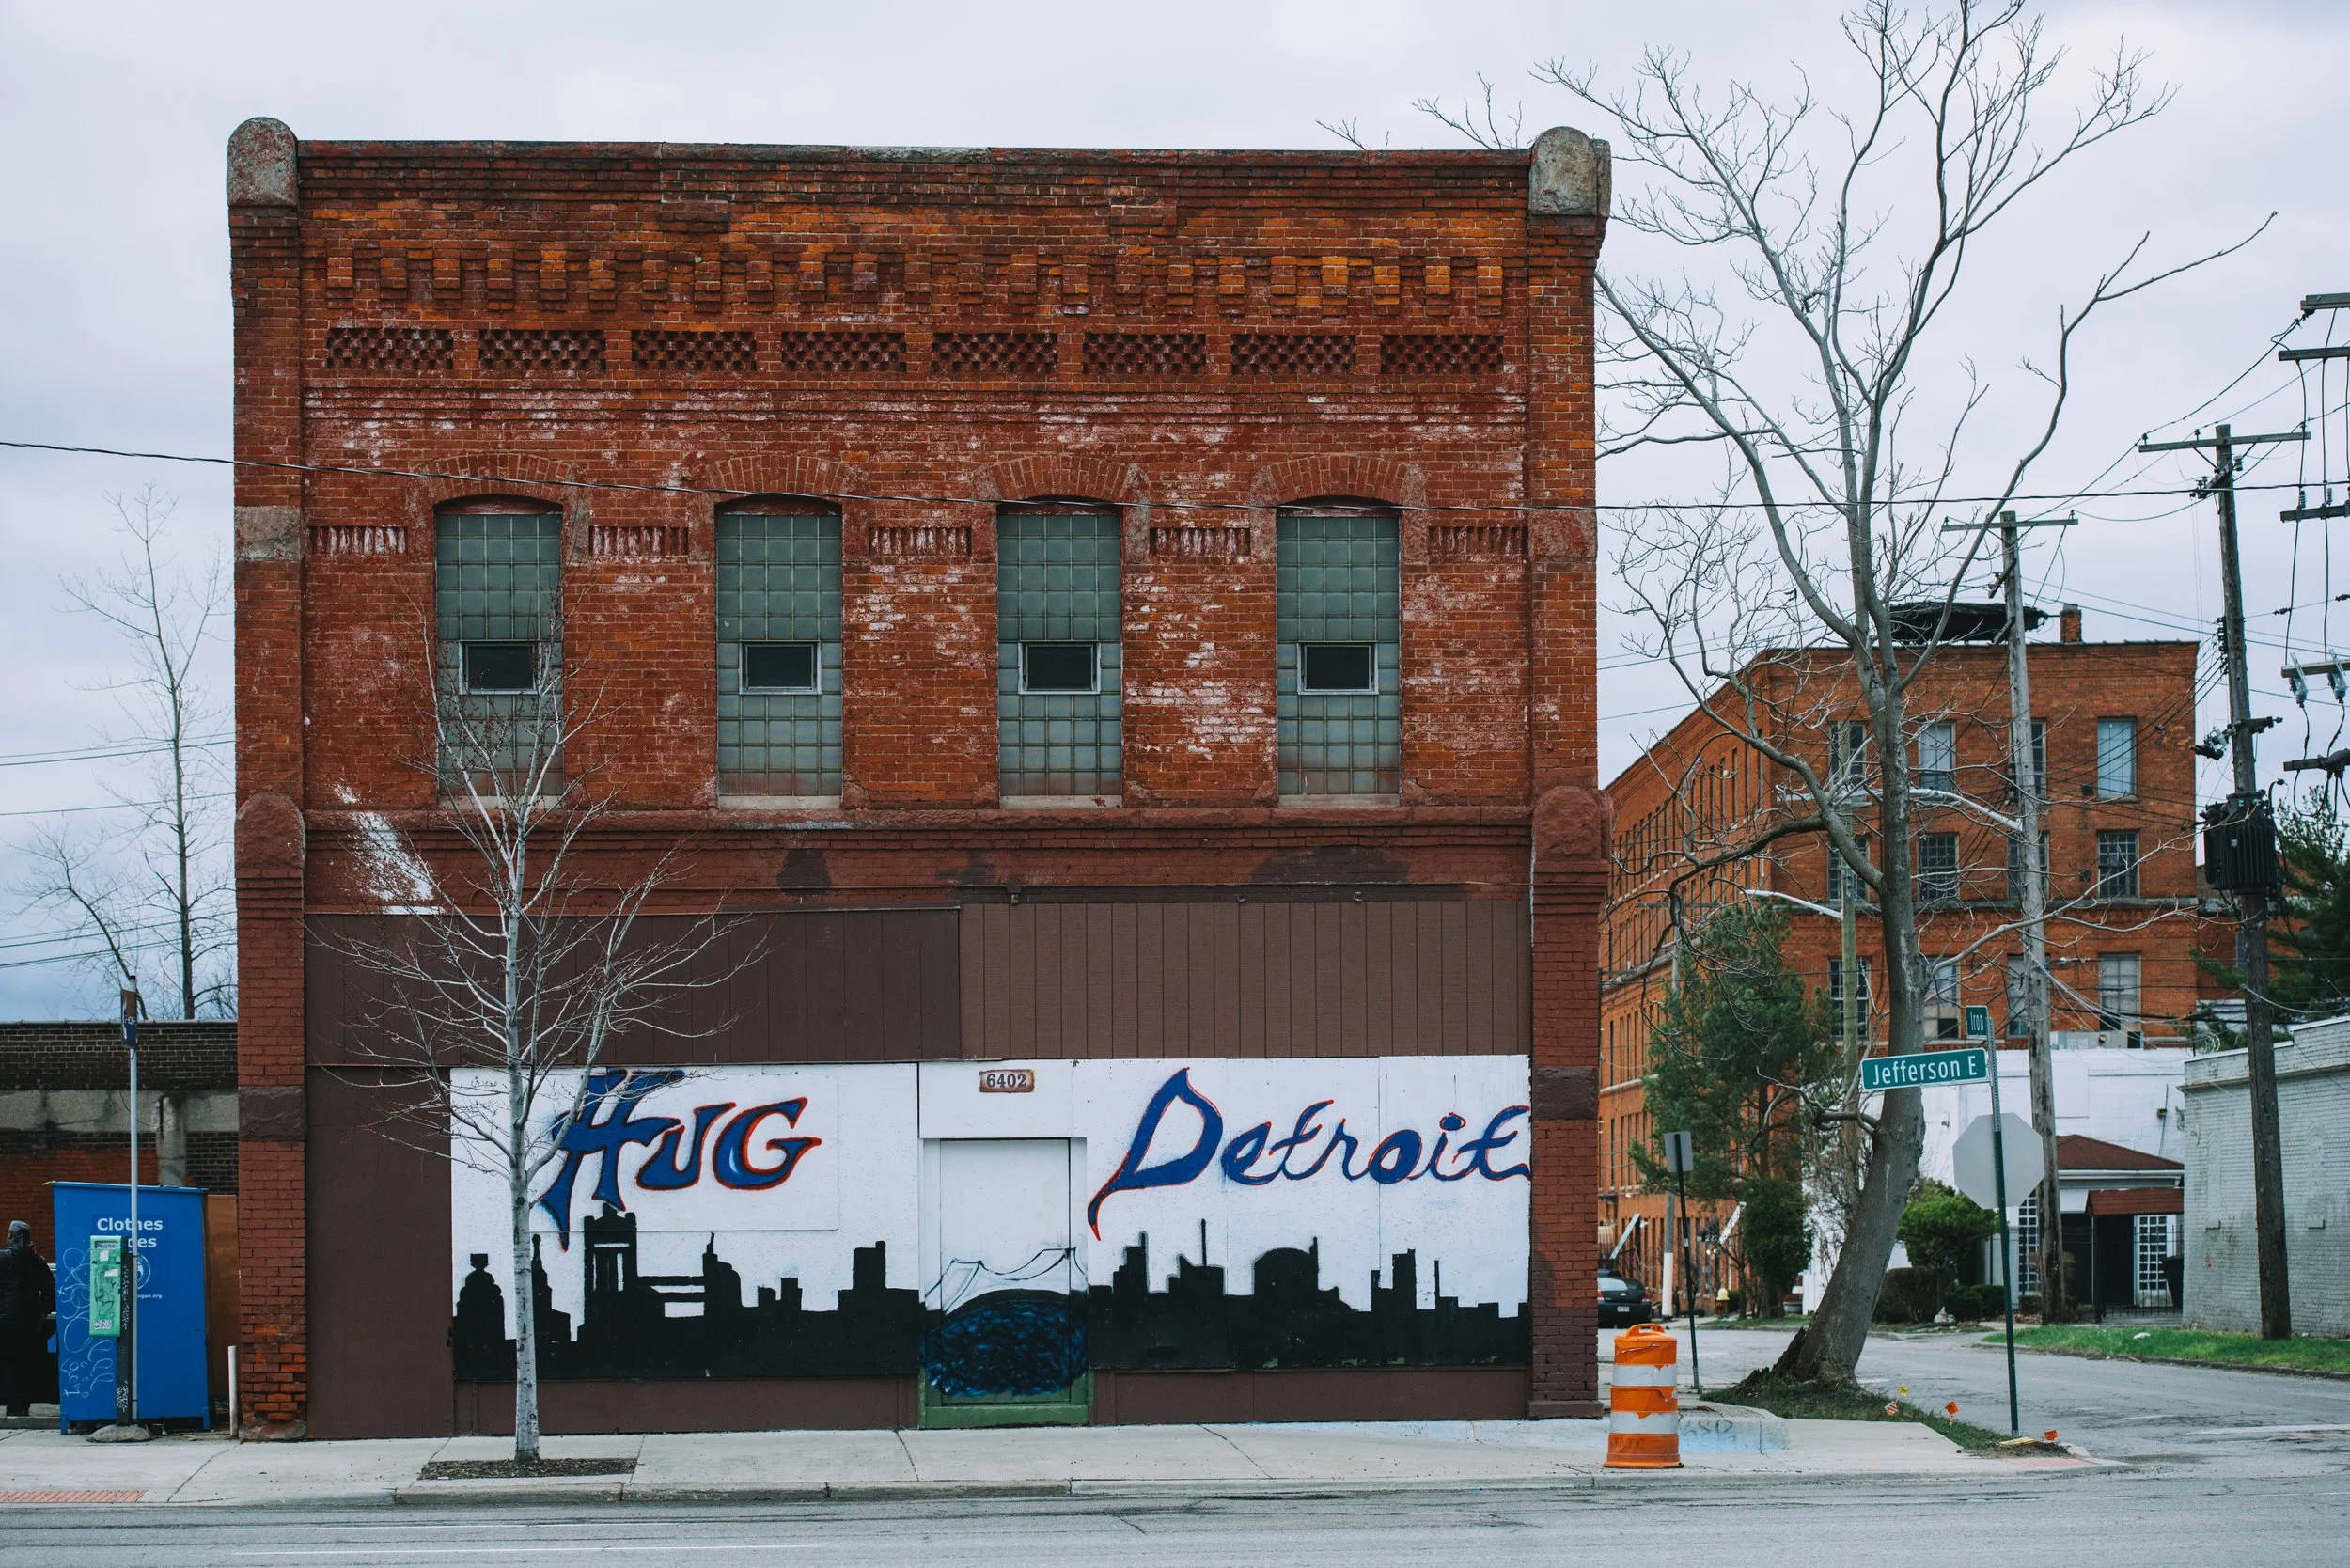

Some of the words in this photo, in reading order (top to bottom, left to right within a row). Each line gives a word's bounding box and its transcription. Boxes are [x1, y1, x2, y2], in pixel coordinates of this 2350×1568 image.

[1970, 1011, 1984, 1031] Iron
[986, 1073, 1027, 1088] 6402
[1872, 1060, 1961, 1086] Jefferson
[1967, 1056, 1977, 1075] E
[1087, 1067, 1531, 1241] Detroit
